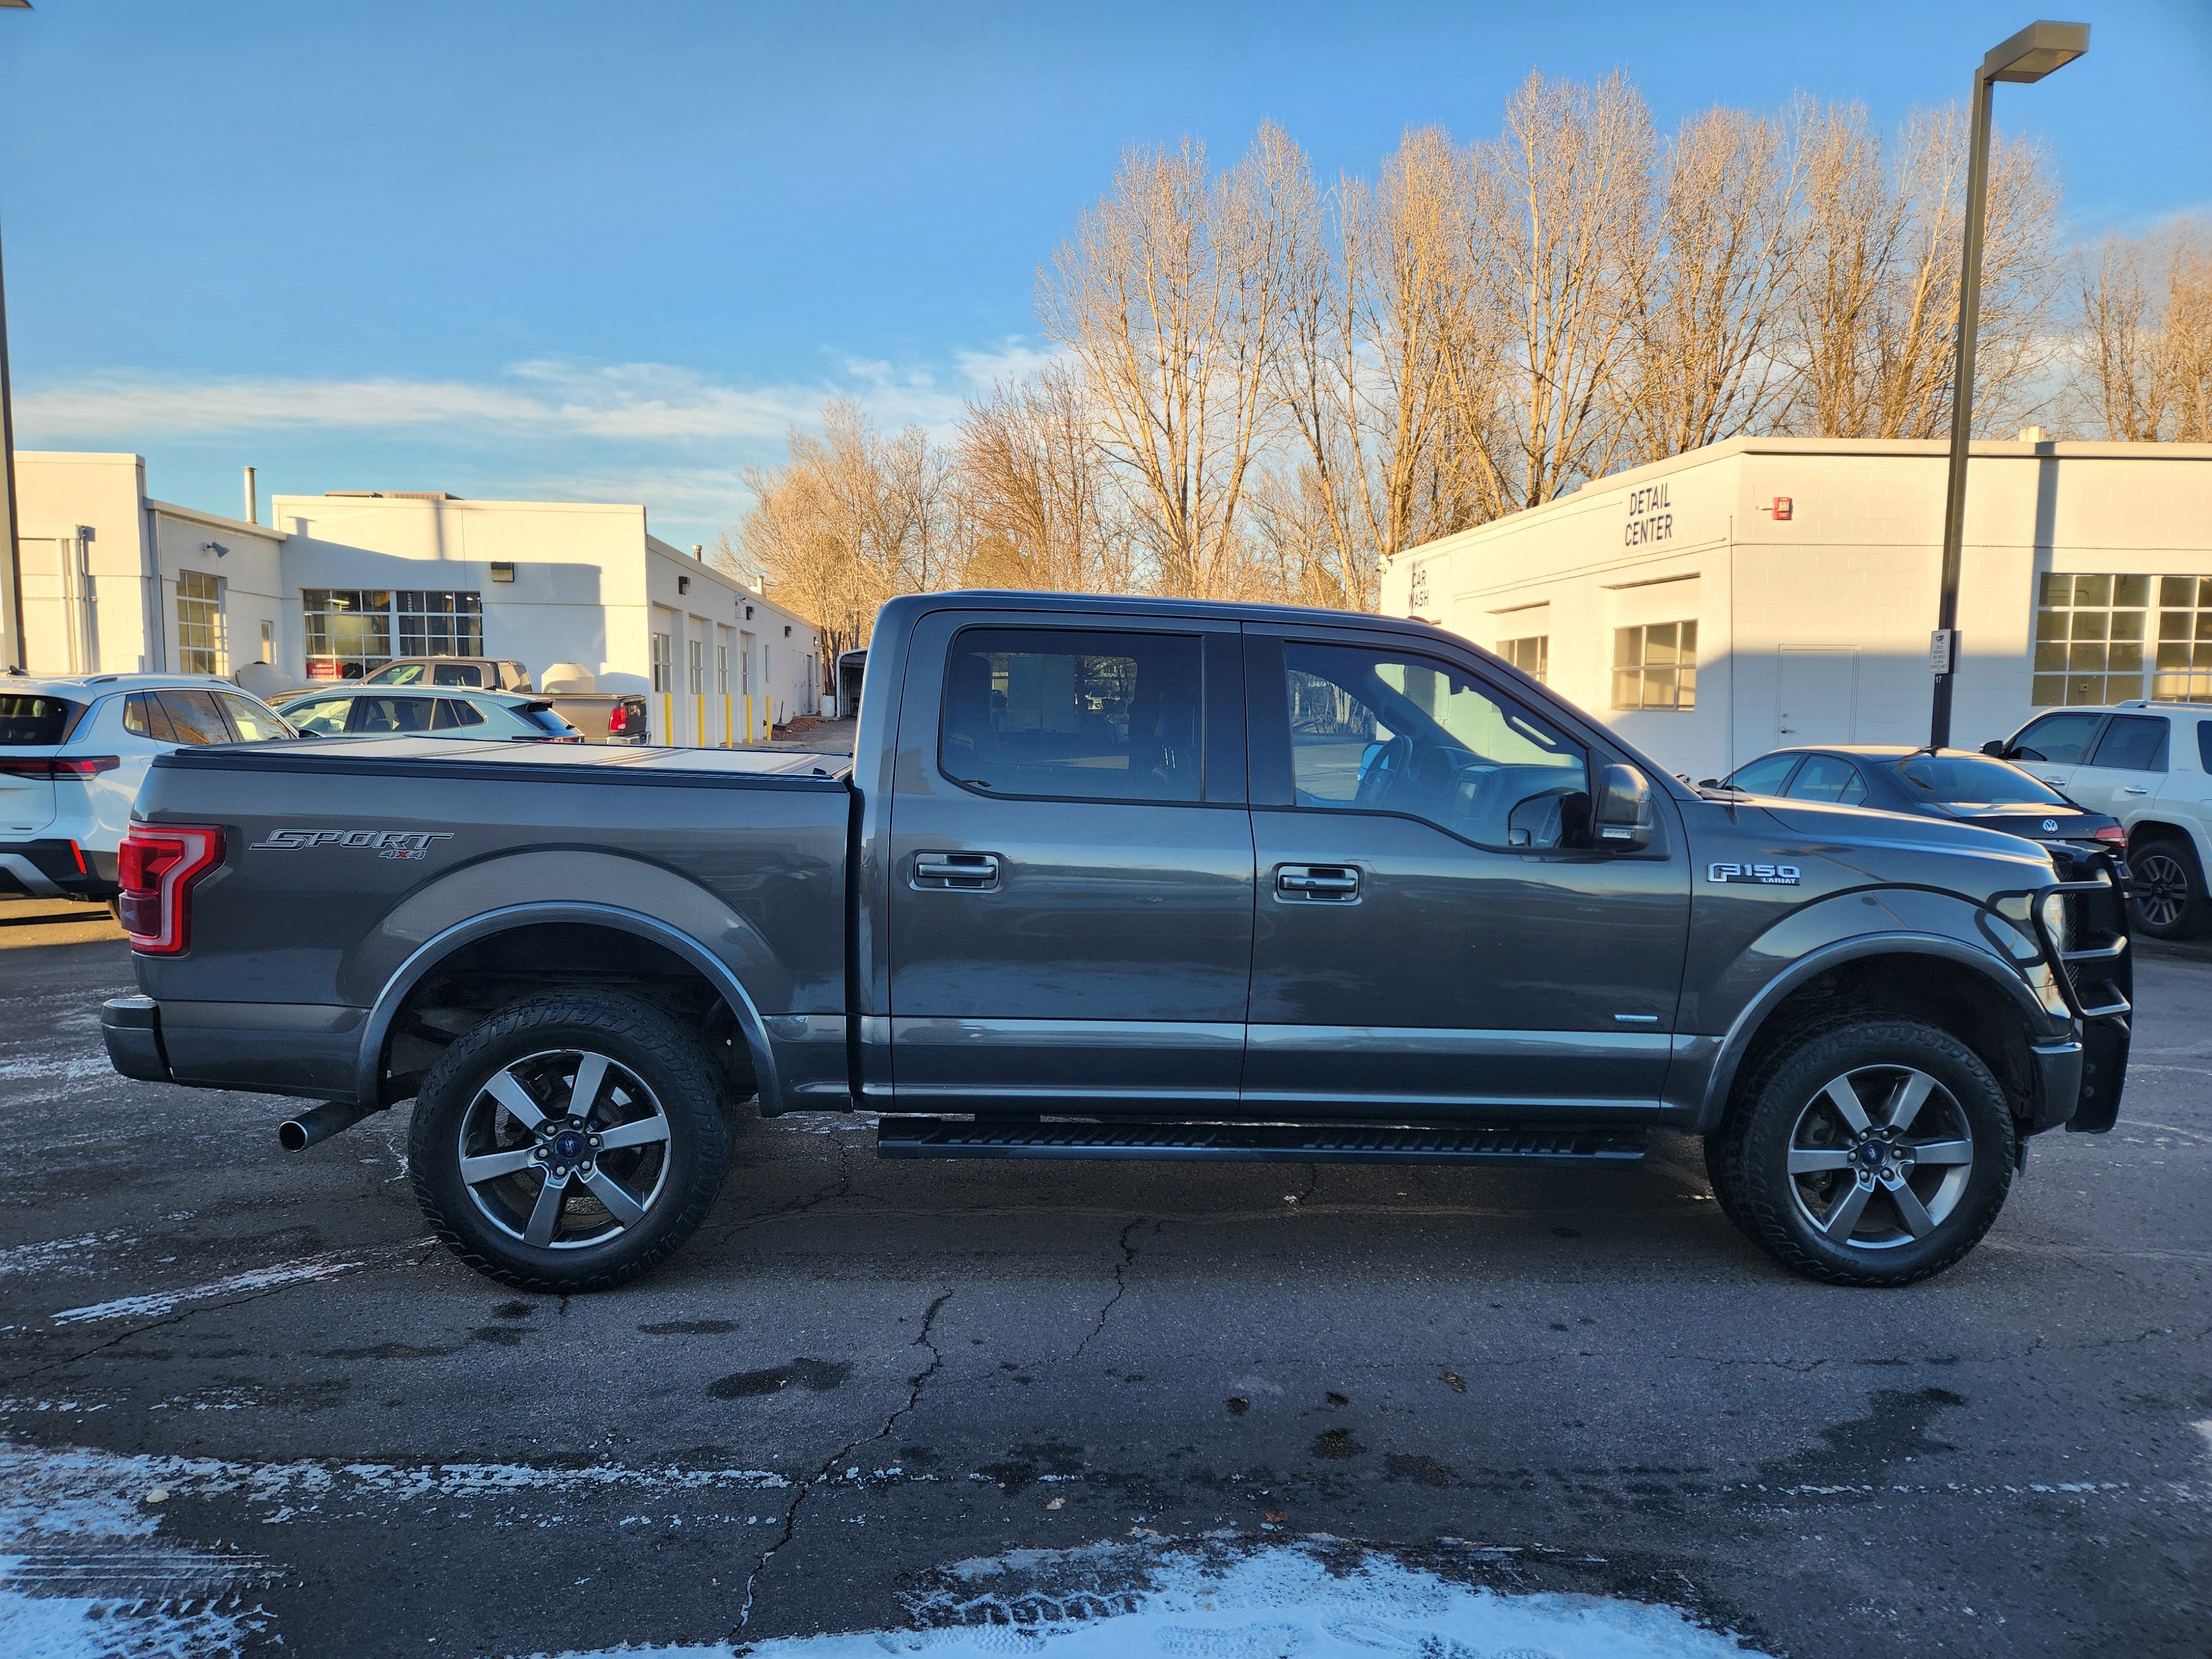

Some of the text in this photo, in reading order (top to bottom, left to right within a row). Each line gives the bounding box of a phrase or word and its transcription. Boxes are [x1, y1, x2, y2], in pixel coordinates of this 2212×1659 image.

[1630, 483, 1671, 516] DETAIL
[1625, 514, 1673, 546] CENTER
[1412, 570, 1426, 588] CAR
[1408, 589, 1429, 609] WASH
[249, 829, 455, 850] SPORT
